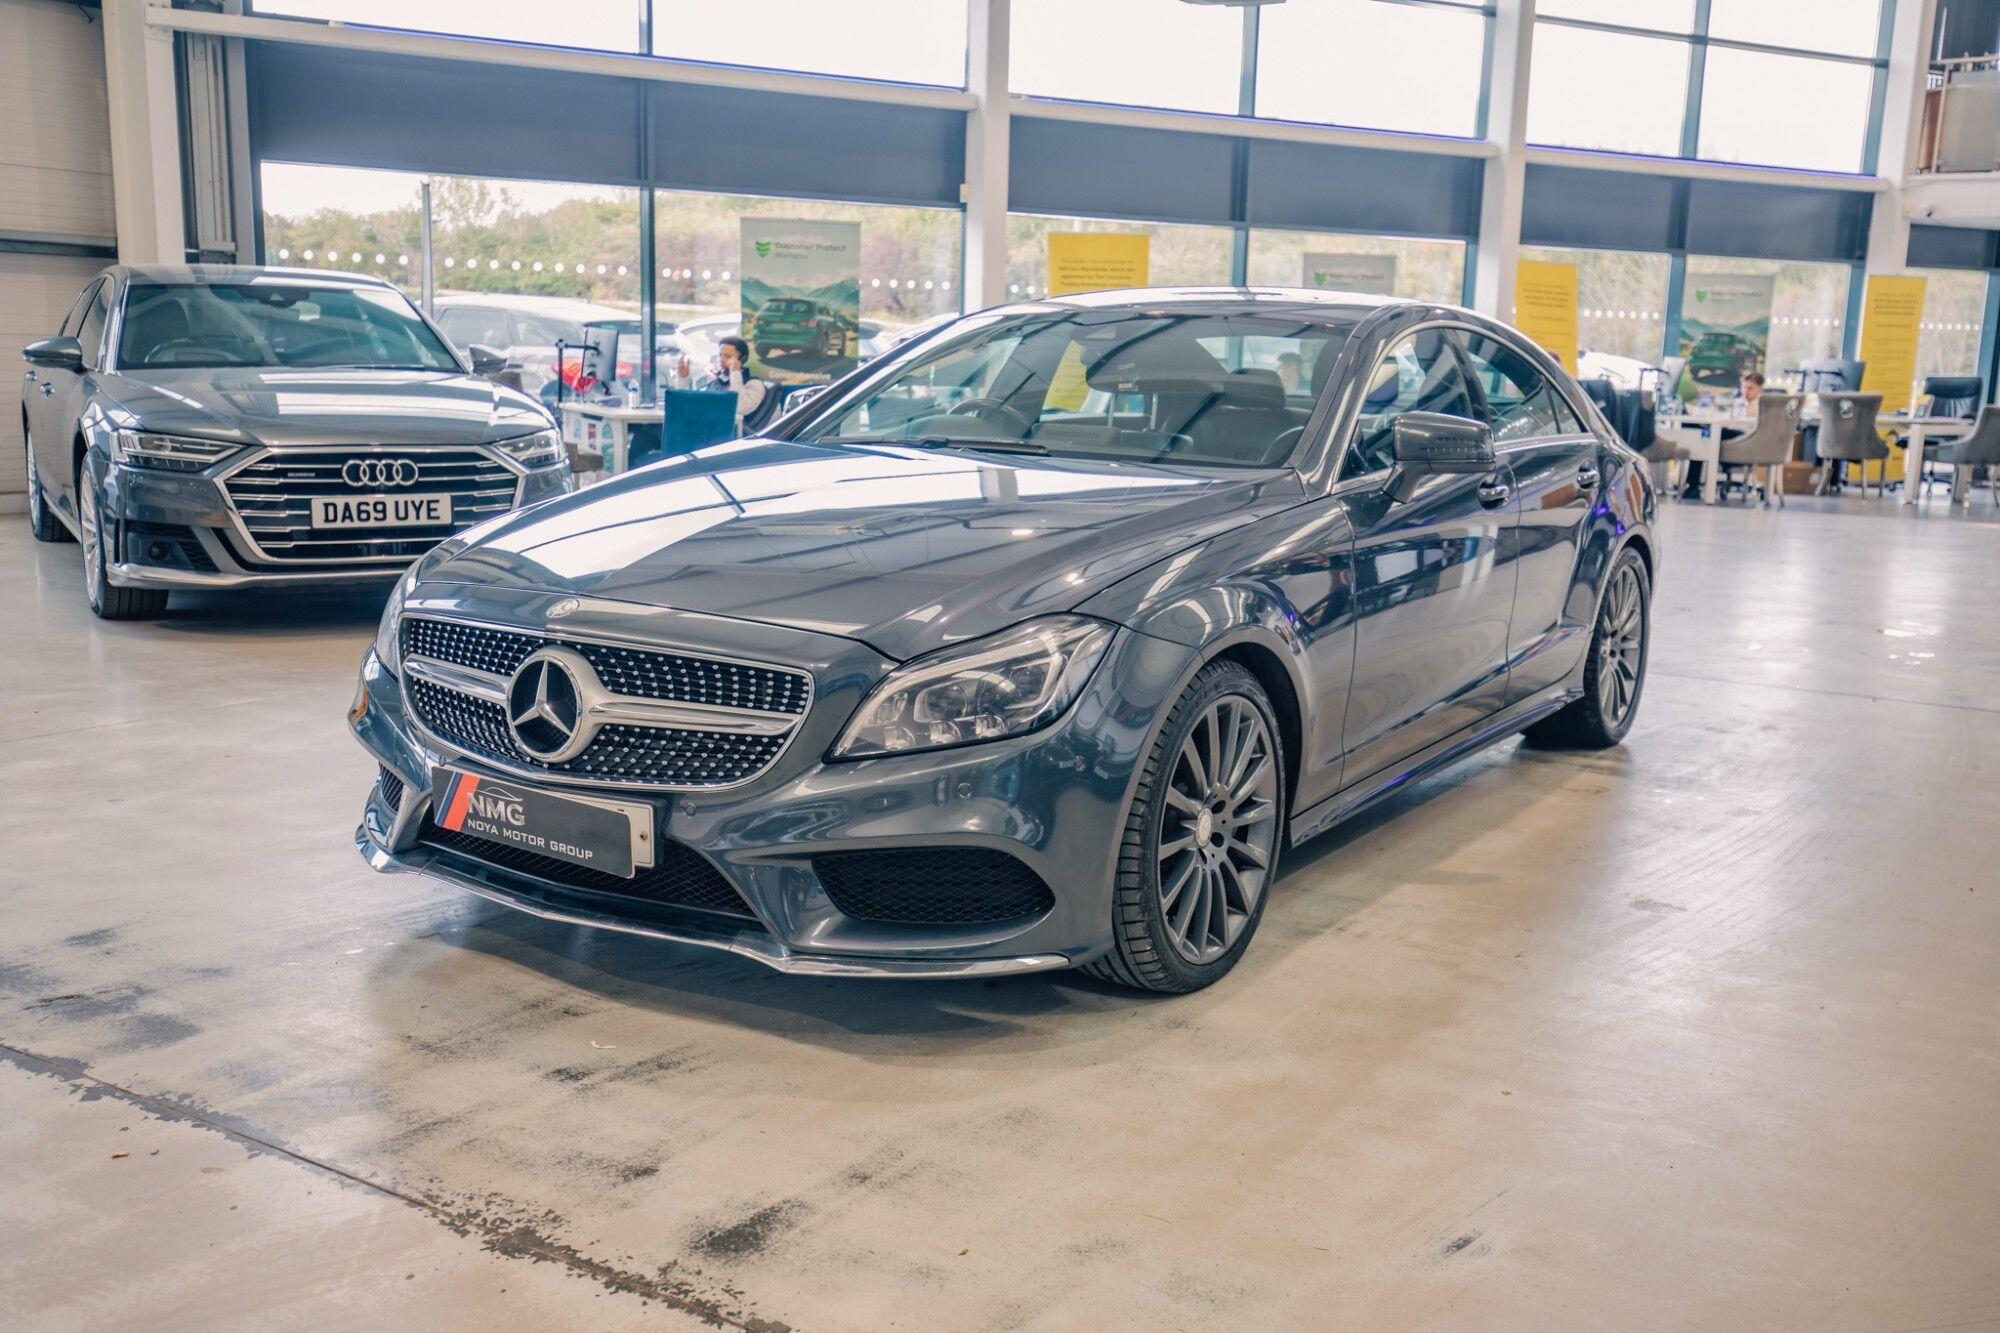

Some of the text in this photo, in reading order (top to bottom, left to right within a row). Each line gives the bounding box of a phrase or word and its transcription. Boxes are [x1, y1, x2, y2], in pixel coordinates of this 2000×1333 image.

[323, 499, 441, 523] DA69 UYE
[466, 792, 526, 826] NMG
[467, 818, 593, 860] NOYA MOTOR GROUP
